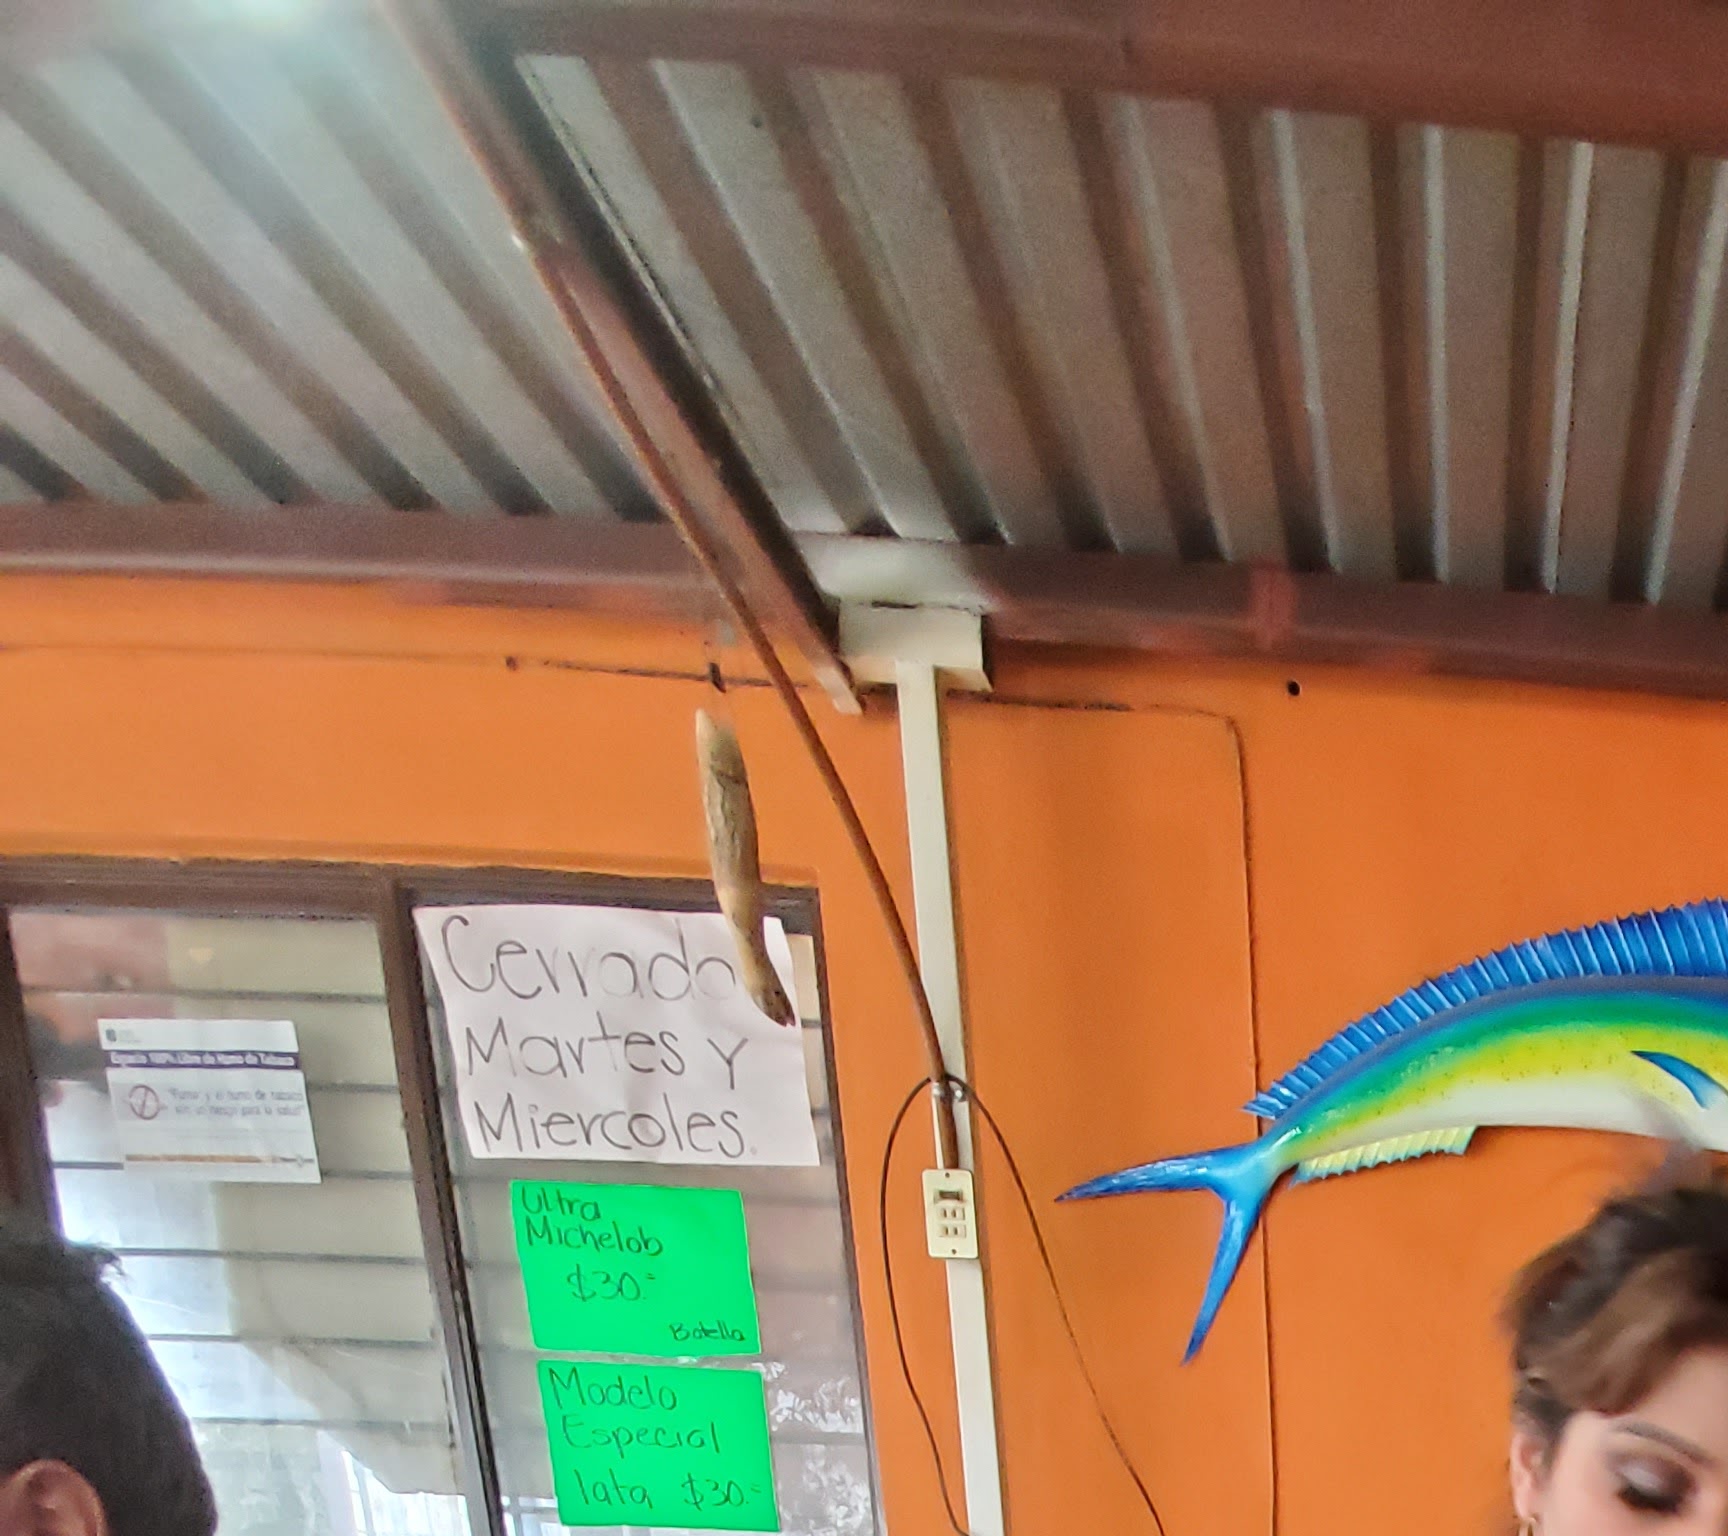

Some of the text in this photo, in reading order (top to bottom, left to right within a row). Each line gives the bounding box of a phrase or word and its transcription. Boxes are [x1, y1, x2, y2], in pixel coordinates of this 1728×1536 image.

[441, 914, 738, 1000] Cerrado
[465, 1010, 686, 1079] Martes
[521, 1186, 602, 1222] Ultra
[525, 1215, 664, 1257] Michelob
[669, 1319, 746, 1342] Botella
[549, 1366, 678, 1411] Modelo
[562, 1413, 721, 1460] Especial
